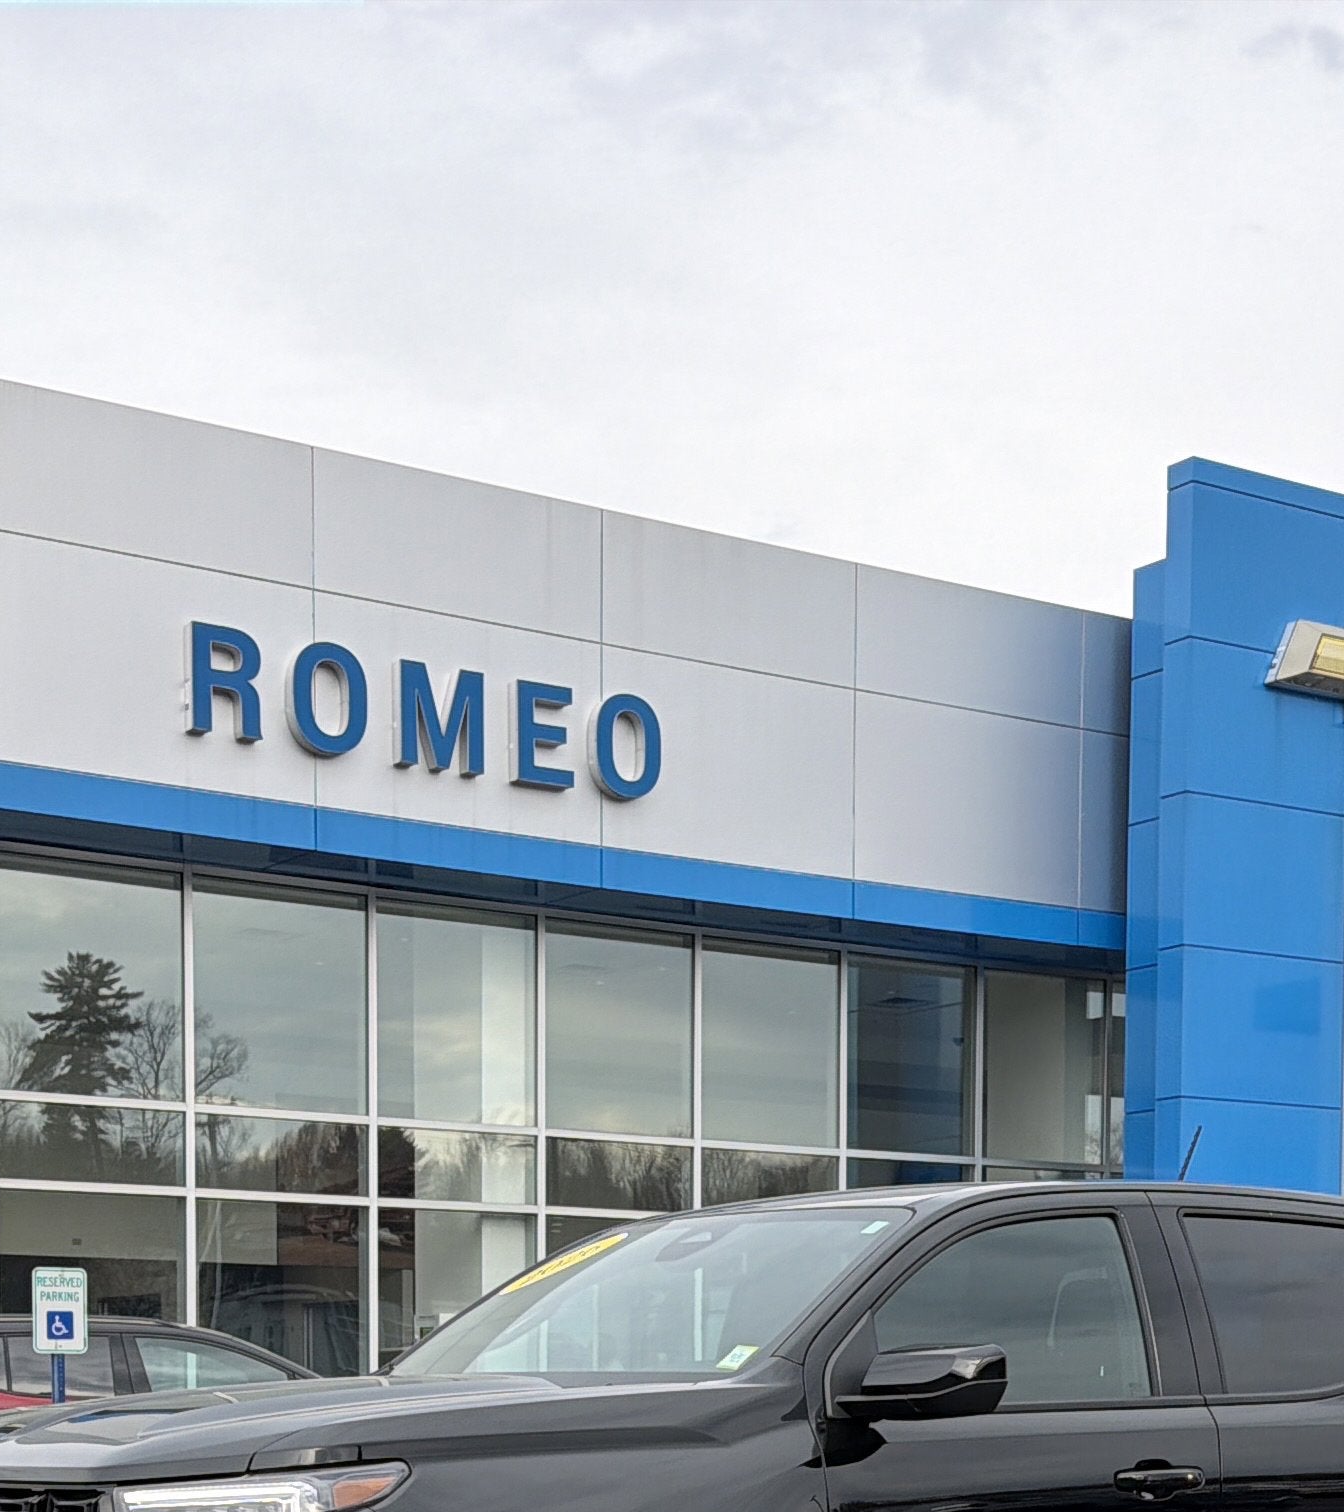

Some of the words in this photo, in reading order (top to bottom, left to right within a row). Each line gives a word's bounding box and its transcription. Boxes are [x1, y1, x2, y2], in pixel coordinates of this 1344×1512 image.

[185, 621, 662, 800] ROMEO
[36, 1276, 83, 1288] RESERVED
[40, 1291, 79, 1302] PARKING
